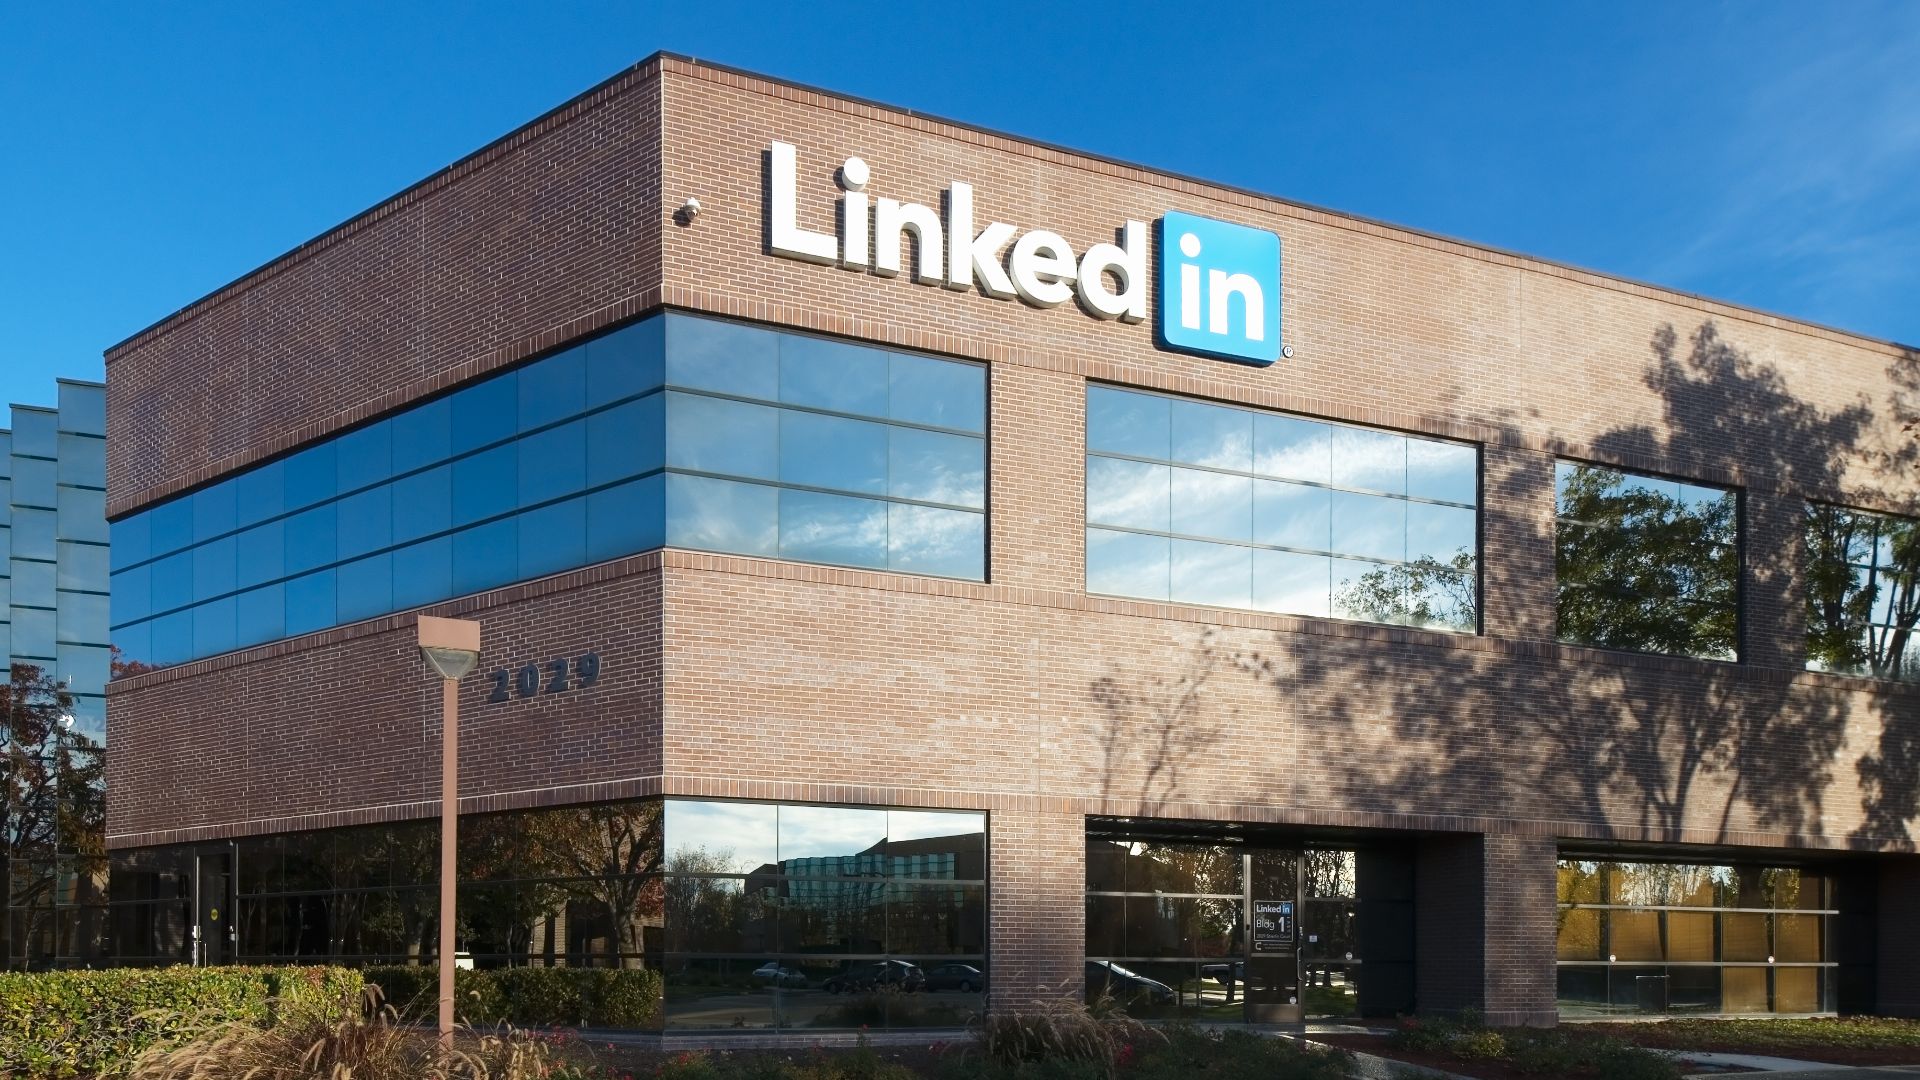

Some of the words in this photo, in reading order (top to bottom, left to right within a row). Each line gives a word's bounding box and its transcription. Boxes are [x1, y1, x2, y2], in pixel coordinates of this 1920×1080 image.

[771, 139, 1147, 324] Linked
[1179, 232, 1265, 342] in
[487, 652, 601, 703] 2029
[1256, 904, 1281, 913] Linked
[1256, 919, 1275, 930] Bldg
[1278, 916, 1285, 932] 1
